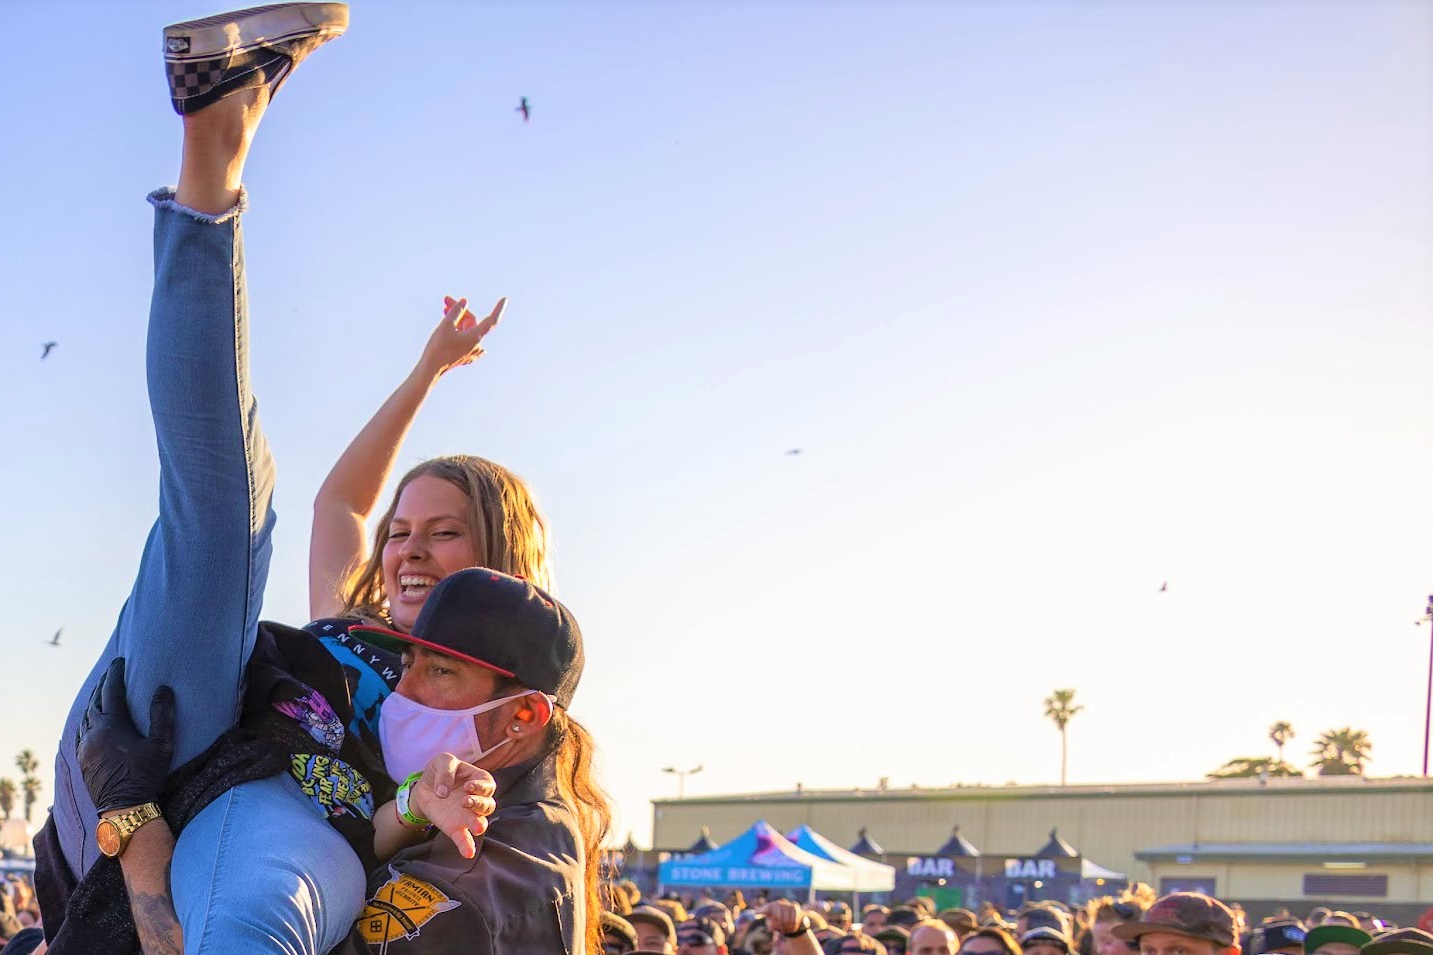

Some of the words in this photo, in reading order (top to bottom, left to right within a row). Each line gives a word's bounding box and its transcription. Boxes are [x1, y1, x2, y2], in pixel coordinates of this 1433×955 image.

[671, 867, 722, 880] STONE
[728, 868, 804, 882] BREWING
[907, 857, 955, 876] BAR
[1005, 859, 1055, 878] BAR
